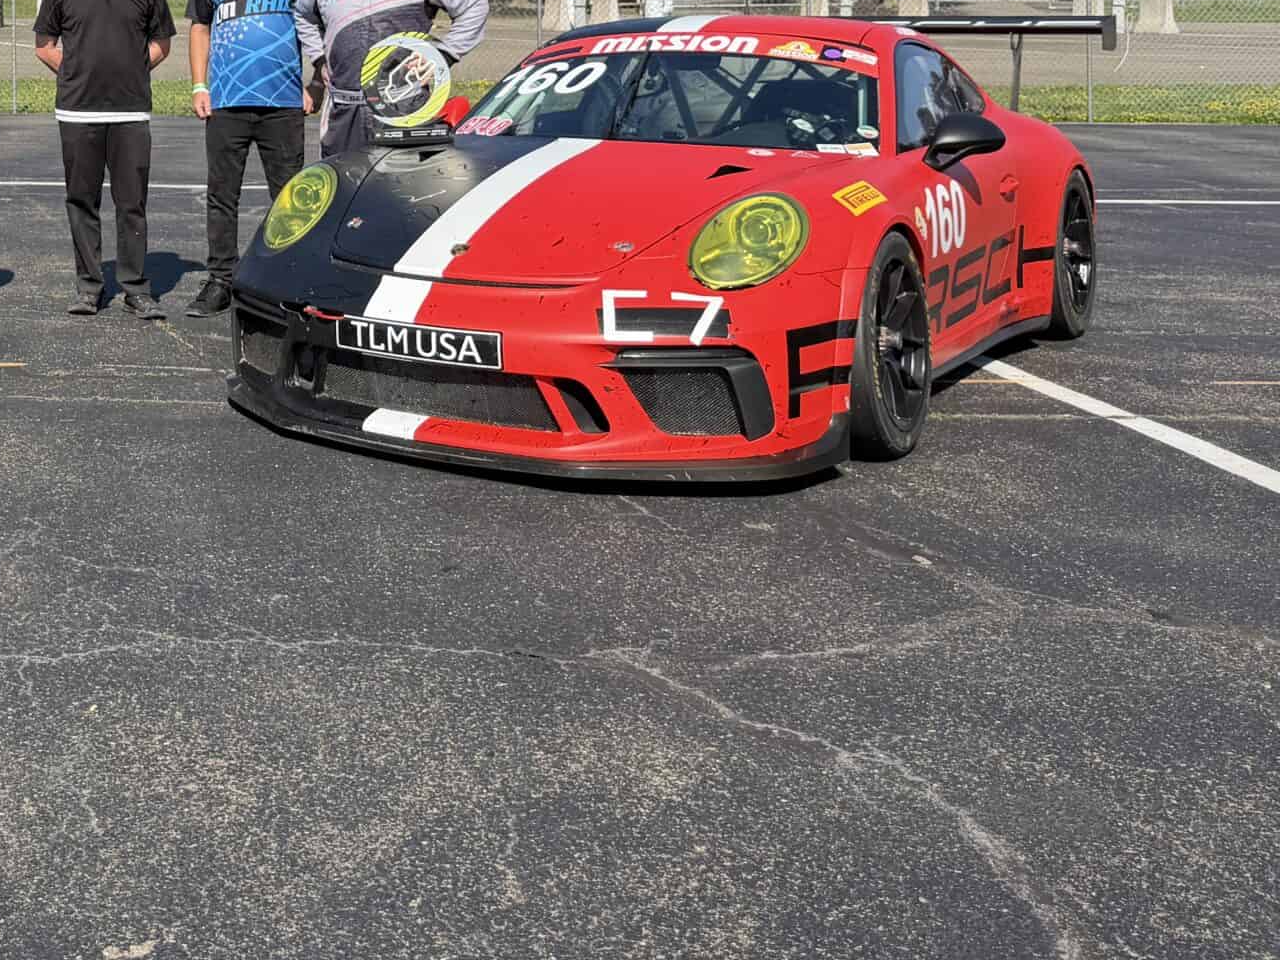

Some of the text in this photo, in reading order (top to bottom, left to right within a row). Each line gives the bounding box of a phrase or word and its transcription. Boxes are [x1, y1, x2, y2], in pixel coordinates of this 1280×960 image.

[497, 61, 607, 97] 160
[841, 184, 880, 209] PIRELLI
[925, 179, 966, 258] 160
[350, 320, 482, 363] TLM USA
